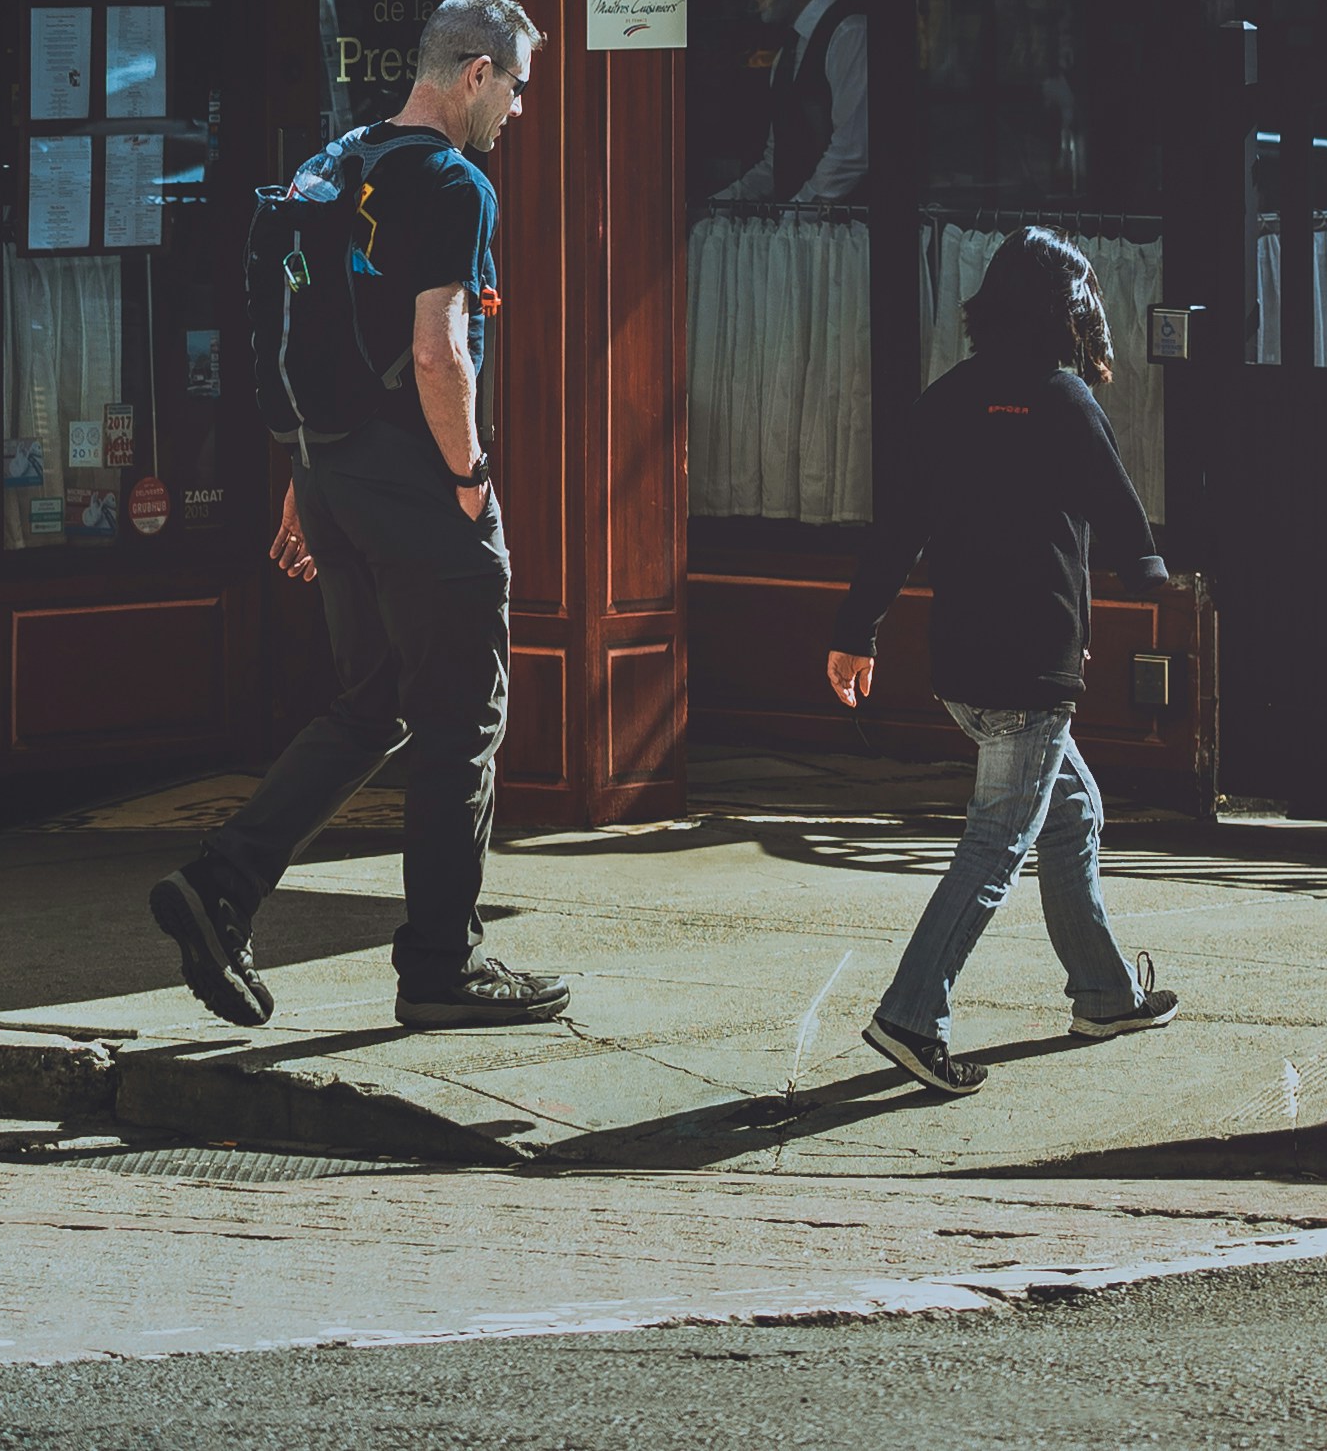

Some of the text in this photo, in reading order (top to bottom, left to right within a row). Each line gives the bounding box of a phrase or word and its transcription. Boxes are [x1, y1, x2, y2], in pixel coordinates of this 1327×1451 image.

[336, 36, 422, 83] Pres
[107, 415, 132, 430] 2017
[184, 489, 224, 503] ZAGAT
[132, 500, 167, 514] GRUBHUB
